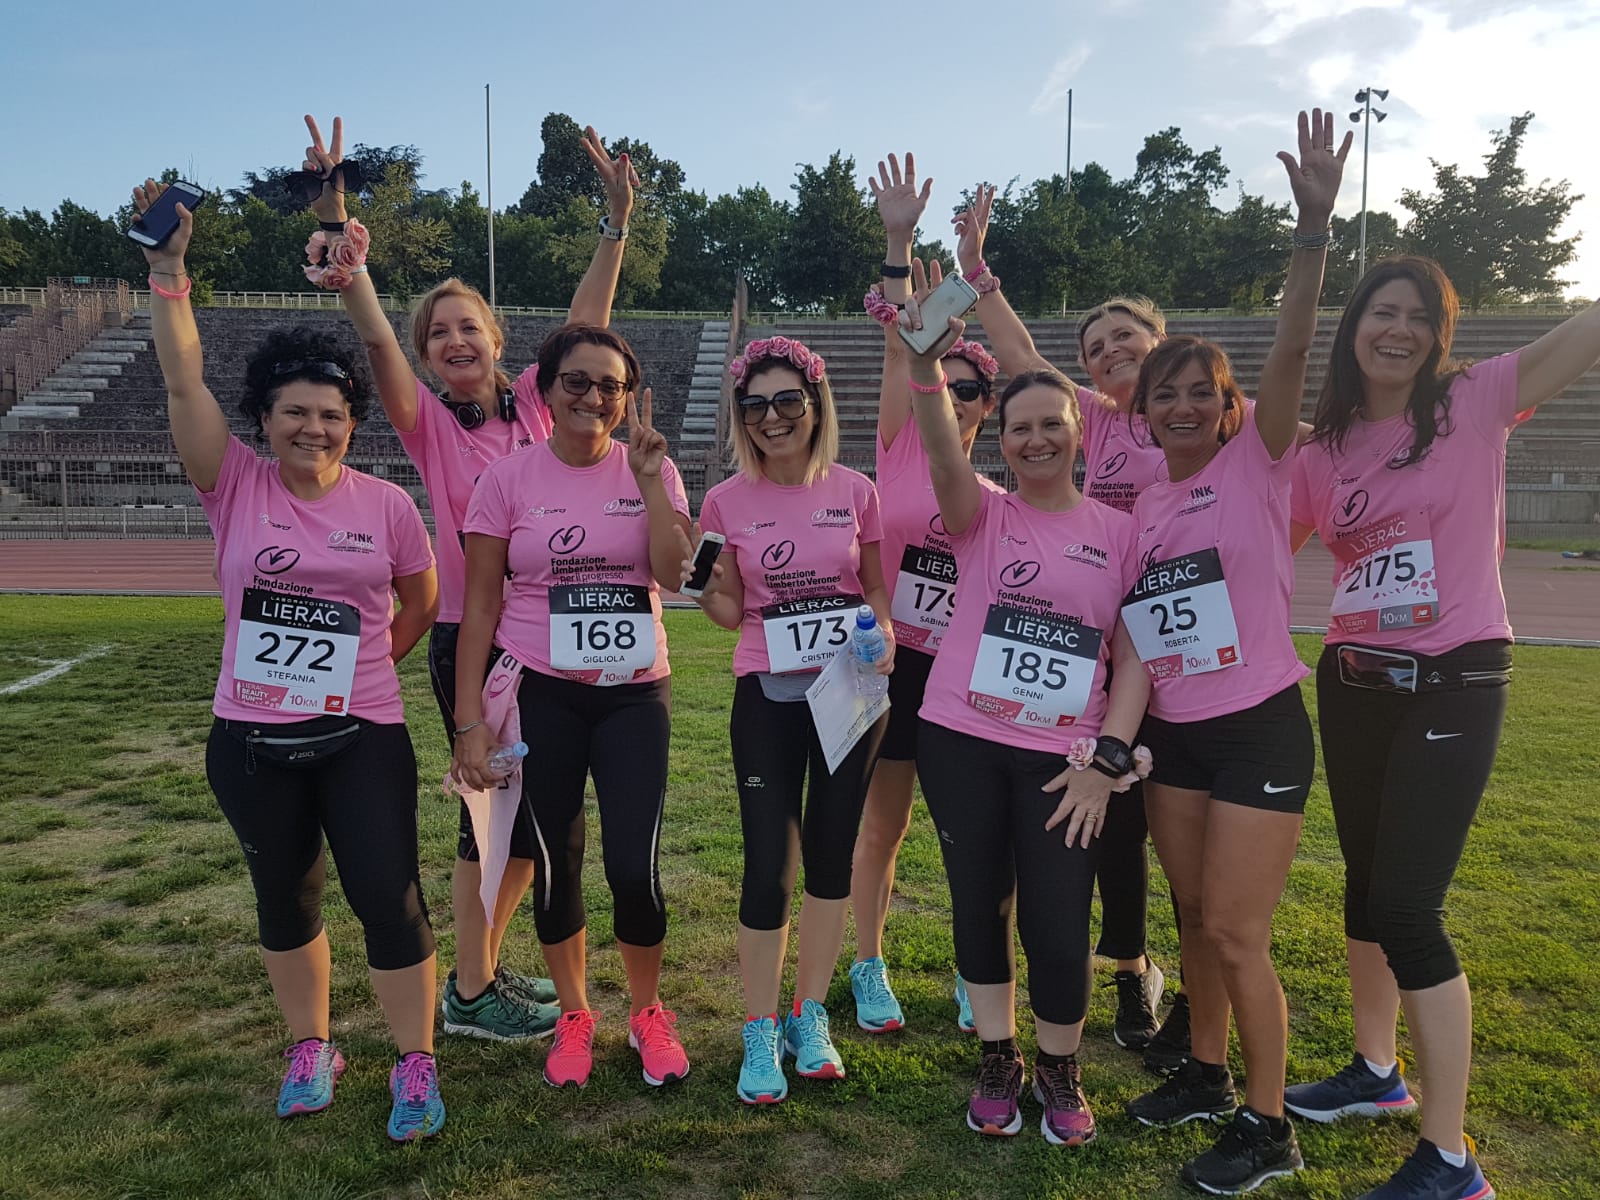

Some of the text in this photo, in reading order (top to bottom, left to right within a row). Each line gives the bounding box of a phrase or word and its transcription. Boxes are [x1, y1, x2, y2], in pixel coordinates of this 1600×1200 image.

[1090, 481, 1135, 490] Fondazione
[1187, 485, 1214, 499] INK
[1088, 490, 1122, 498] Umberto
[618, 497, 643, 508] PINK
[826, 508, 851, 517] PINK
[346, 531, 374, 544] PINK
[1350, 521, 1407, 553] LIERAC
[1082, 545, 1107, 560] PINK
[551, 556, 607, 567] Fondazione
[552, 562, 635, 575] Umberto Veronesi
[582, 572, 624, 582] progresso
[764, 569, 816, 581] Fondazione
[806, 574, 841, 585] Verones
[1134, 563, 1200, 595] LIERAC
[1345, 551, 1416, 594] 2175
[253, 575, 314, 595] Fondazione
[795, 584, 836, 595] progresso
[270, 596, 335, 609] LABORATOIRES
[568, 592, 636, 607] LIERAC
[779, 598, 846, 613] LIERAC
[997, 589, 1053, 608] Fondazione
[261, 600, 340, 626] LIERAC
[1040, 607, 1084, 625] Veronesi
[1149, 596, 1198, 636] 25
[1382, 612, 1408, 625] 10KM
[919, 615, 949, 627] SABINA
[570, 619, 636, 651] 168
[787, 615, 848, 652] 173
[1004, 617, 1080, 648] LIERAC
[1164, 635, 1200, 649] ROBERTA
[254, 631, 336, 672] 272
[801, 651, 839, 663] CRISTIN
[582, 655, 626, 664] GIGLIOLA
[1186, 657, 1211, 669] 10KM
[1001, 647, 1070, 690] 185
[267, 670, 316, 684] STEFANIA
[605, 673, 628, 682] 10KM
[241, 687, 269, 698] BEAUTY
[1012, 686, 1044, 700] GENNI
[289, 694, 318, 708] 10KM
[976, 699, 1005, 711] BEAUTY
[1025, 710, 1051, 725] 10KM
